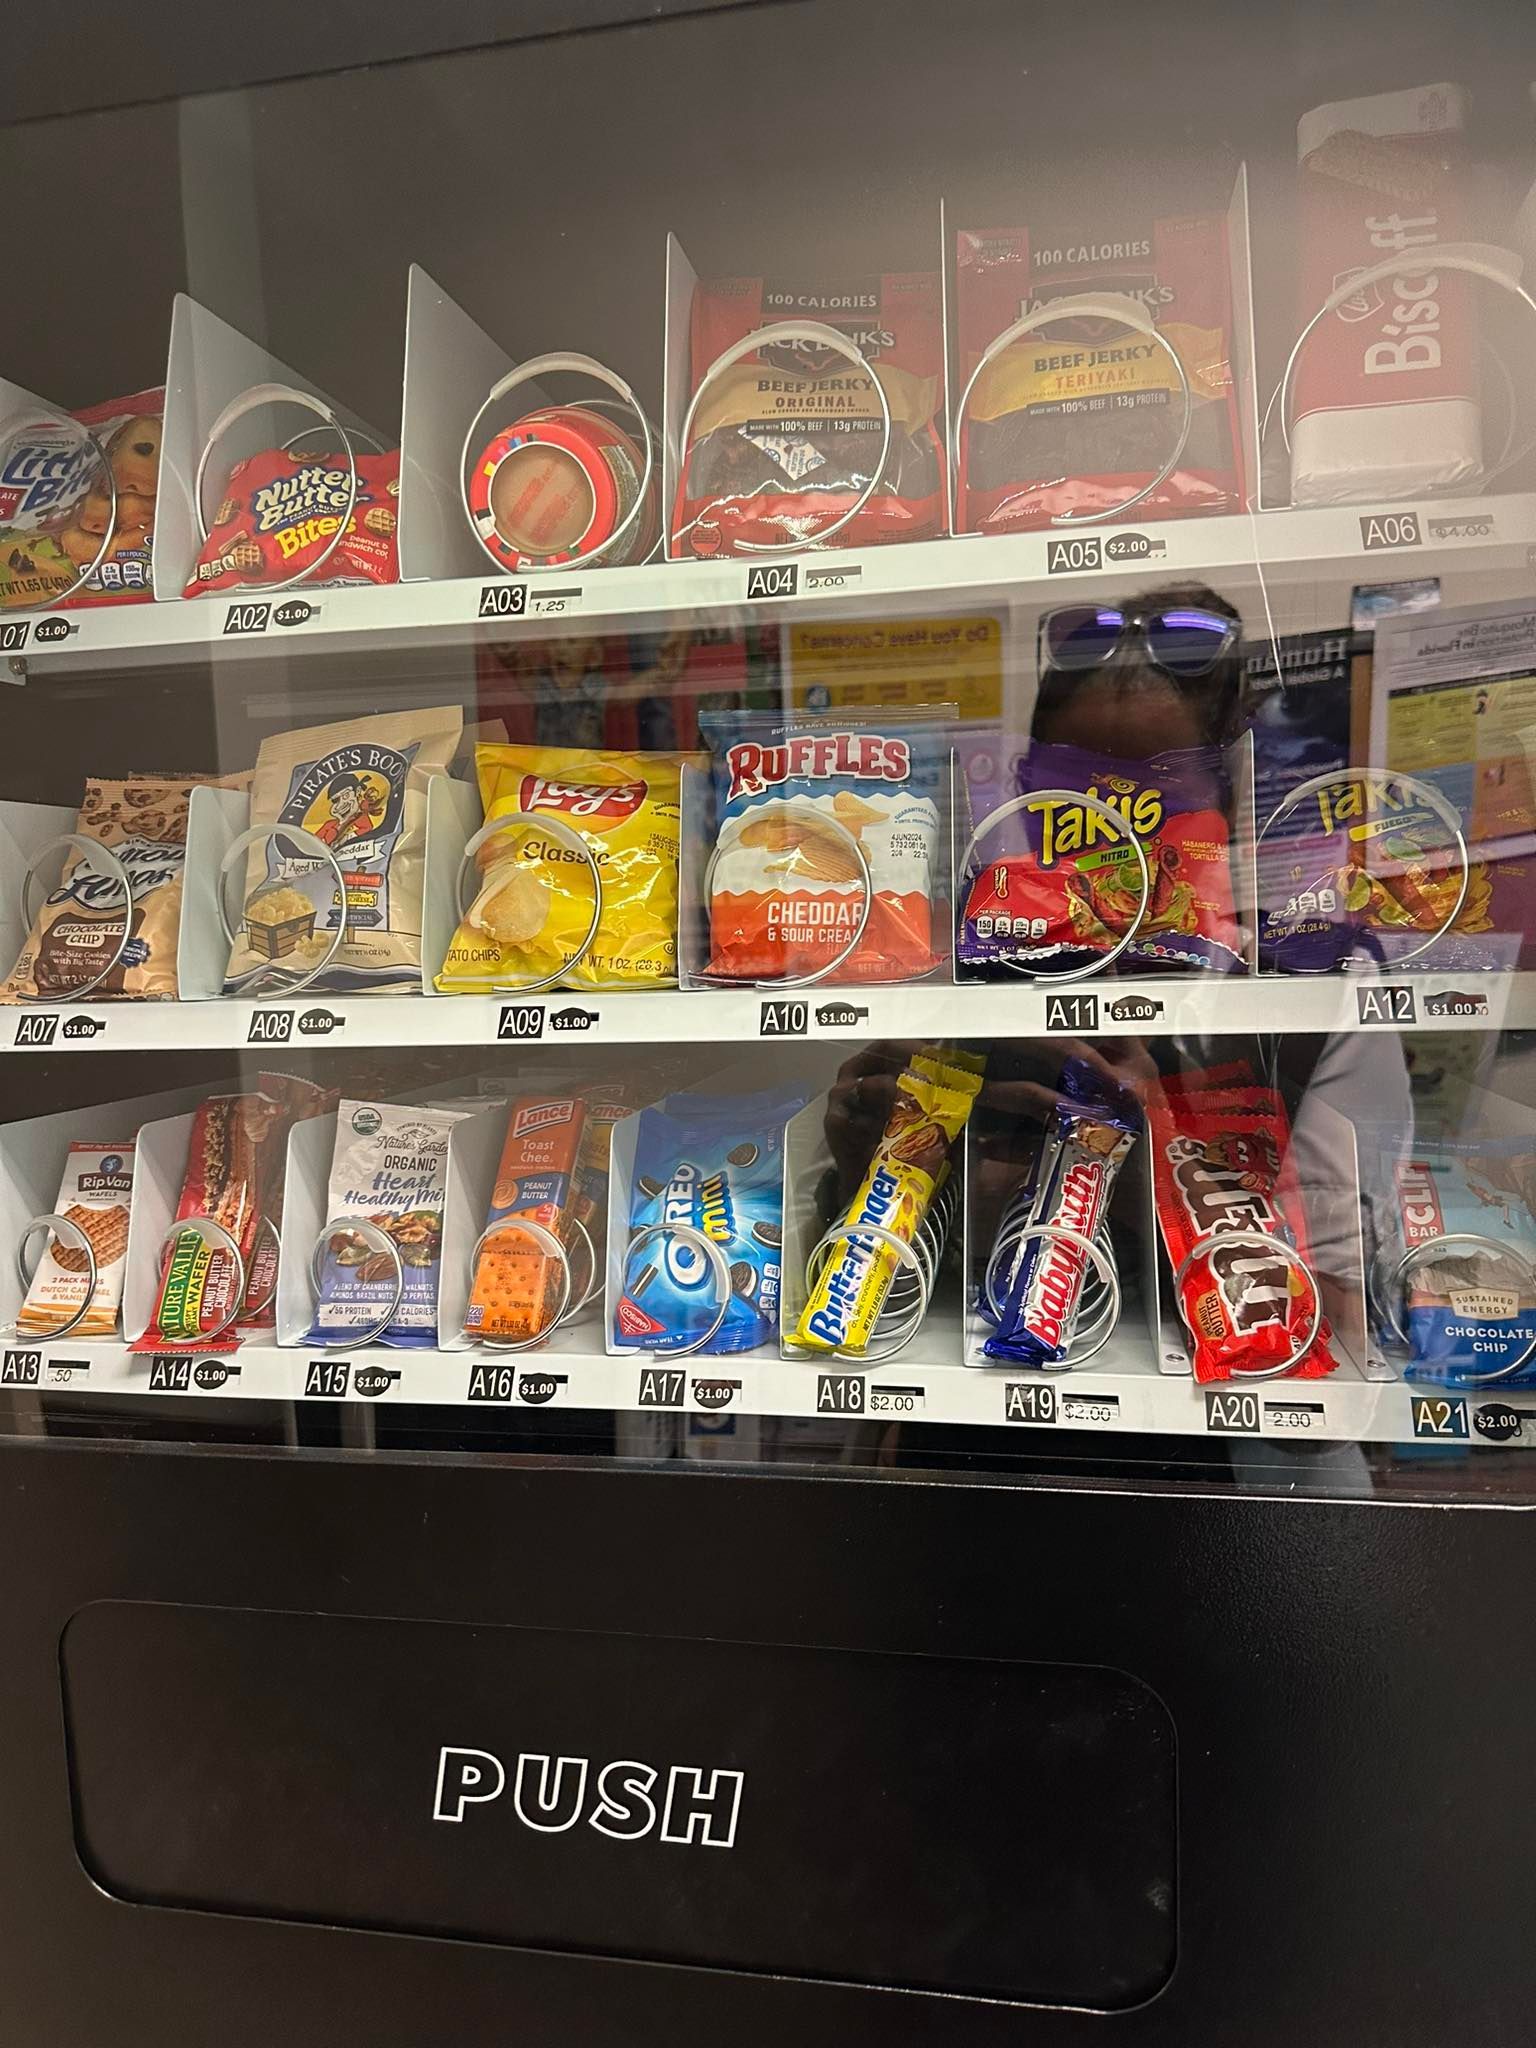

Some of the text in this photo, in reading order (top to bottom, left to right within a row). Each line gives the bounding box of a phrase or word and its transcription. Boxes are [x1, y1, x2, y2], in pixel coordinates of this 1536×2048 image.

[1034, 240, 1151, 267] 100 CALORIES
[767, 294, 877, 309] 100 CALORIES
[1364, 213, 1441, 375] Biscff
[1033, 343, 1157, 373] BEEF JERKY
[757, 378, 874, 396] BEEF JERKY
[1056, 367, 1136, 389] TERIYAKI
[776, 397, 856, 409] ORIGINAL
[1061, 393, 1166, 413] 100% BEEF 13g PROTEIN
[780, 421, 881, 432] 100% BEEF 13g PROTEIN
[256, 466, 364, 512] Nutter
[274, 516, 357, 559] Bites
[1366, 516, 1416, 546] A06
[1052, 540, 1148, 571] A05 $2.00
[21, 579, 41, 592] 1.65
[749, 568, 845, 595] A04 2.00
[481, 588, 566, 614] A03 1.25
[226, 607, 309, 630] A02 $1.00
[37, 625, 68, 637] $1.00
[291, 749, 362, 809] PIRATE'S
[728, 733, 911, 804] RUFFLES
[527, 777, 636, 816] Lay's
[1027, 787, 1162, 865] Takis
[289, 862, 309, 874] Aged
[1100, 849, 1130, 863] NITRO
[1189, 852, 1220, 862] TORTILLA
[768, 901, 865, 926] CHEDDAR
[978, 920, 991, 929] 150
[55, 924, 127, 935] CHOCOLATE
[70, 934, 100, 945] CHIP
[768, 927, 776, 942] &
[781, 928, 814, 943] SOUR
[1296, 924, 1307, 934] OZ
[53, 957, 105, 966] with Taste
[83, 951, 111, 960] Cookies
[470, 948, 501, 962] CHIPS
[608, 957, 614, 969] 1
[1048, 999, 1153, 1027] A11 $1.00
[1362, 990, 1413, 1020] A12
[17, 1018, 95, 1042] A07 $1.00
[251, 1014, 332, 1039] A08 $1.00
[500, 1010, 588, 1035] A09 $1.00
[762, 1005, 855, 1031] A10 $1.00
[518, 1104, 570, 1128] Lance
[522, 1139, 555, 1150] Toast
[384, 1154, 438, 1171] ORGANIC
[372, 1171, 437, 1191] Heart
[524, 1182, 553, 1190] PEANUT
[89, 1190, 118, 1198] WAFELS
[344, 1190, 416, 1212] Healthy
[521, 1191, 549, 1200] BUTTER
[699, 1173, 731, 1242] mini
[665, 1163, 707, 1285] OREO
[1408, 1226, 1439, 1238] BAR
[173, 1227, 201, 1280] VALLEY
[58, 1277, 79, 1285] PACK
[187, 1250, 211, 1305] WAFER
[201, 1254, 224, 1318] PEANUT BUTTER
[214, 1263, 234, 1308] CHOCOLATE
[248, 1267, 264, 1295] PEANUT
[344, 1306, 434, 1315] PROTEIN CALORIES
[1456, 1294, 1514, 1305] SUSTAINED
[1462, 1305, 1509, 1315] ENERGY
[623, 1307, 650, 1330] NABISCO
[1198, 1304, 1213, 1338] PEANUT
[1206, 1294, 1226, 1338] BUTTER
[1444, 1326, 1534, 1340] CHOCOLATE
[1472, 1341, 1509, 1354] CHIP
[3, 1356, 38, 1382] A13
[153, 1361, 227, 1386] A14 $1.00
[307, 1367, 388, 1393] A15 $1.00
[471, 1368, 554, 1397] A16 $1.00
[641, 1373, 730, 1402] A17 $1.00
[818, 1379, 914, 1412] A18 $2.00
[1007, 1387, 1111, 1422] A19 $2.00
[1209, 1395, 1311, 1428] A20 2.00
[1416, 1400, 1518, 1434] A21 $2.00
[432, 1746, 745, 1849] PUSH
